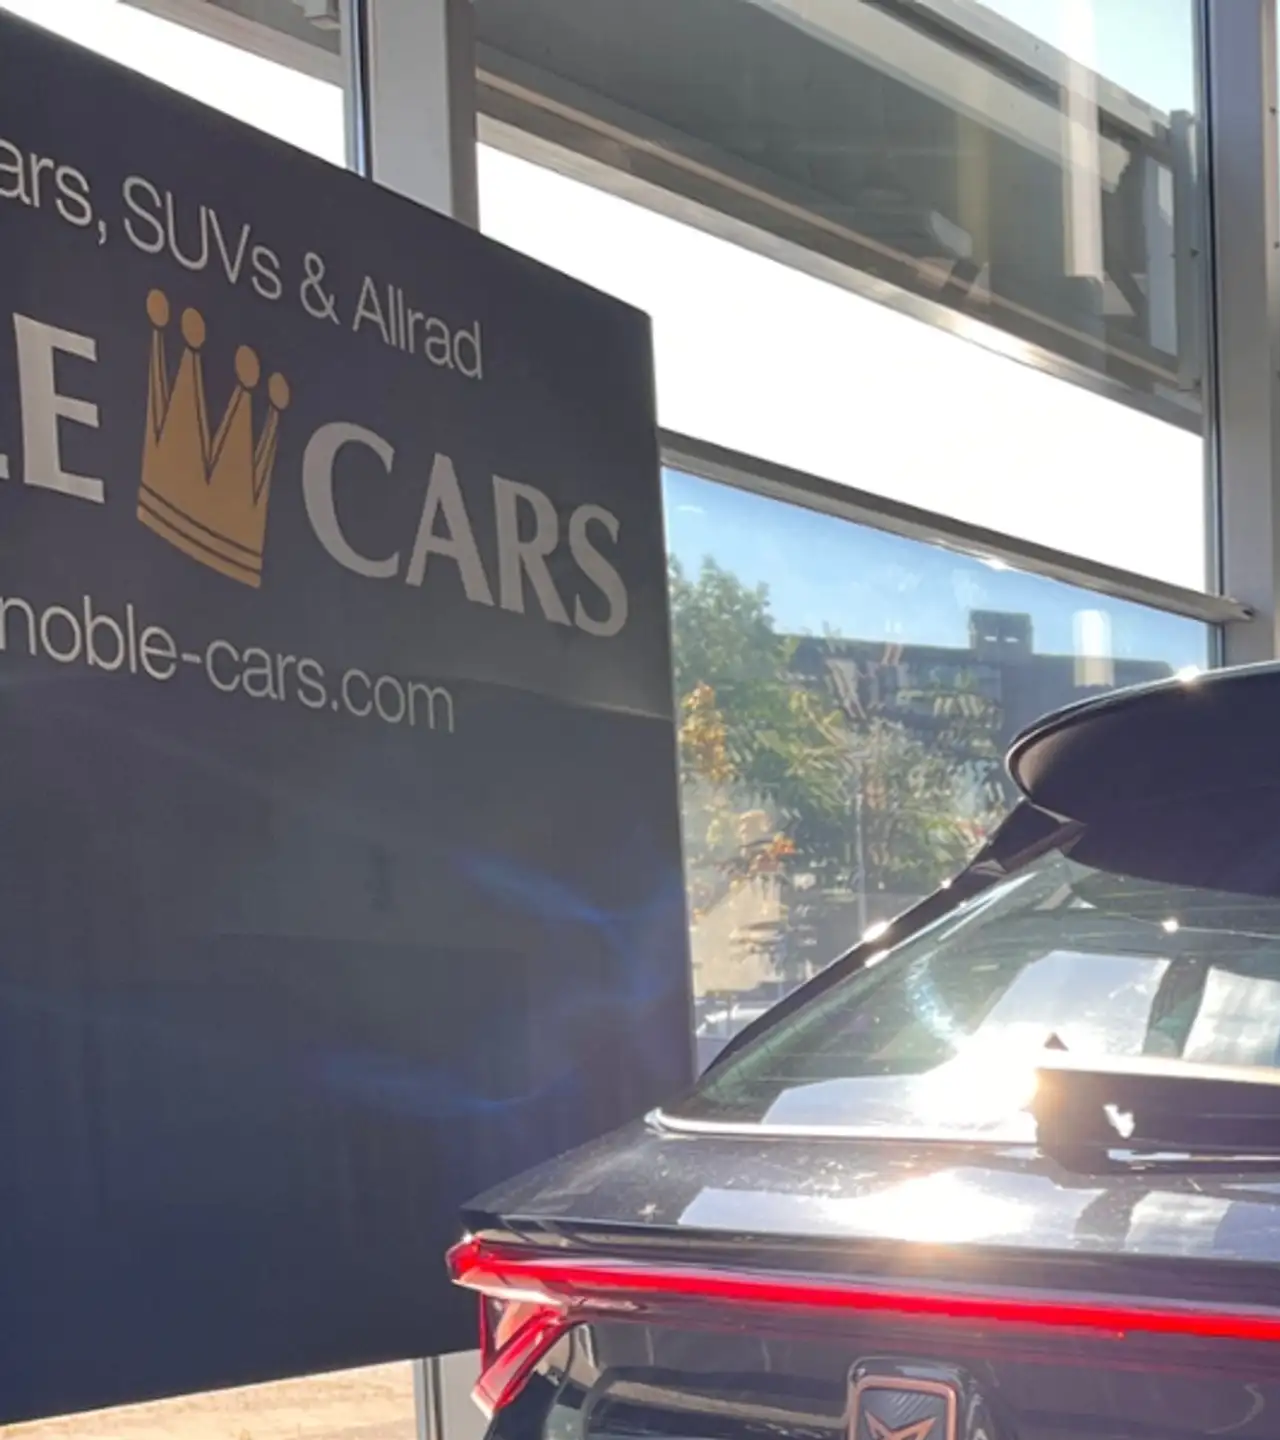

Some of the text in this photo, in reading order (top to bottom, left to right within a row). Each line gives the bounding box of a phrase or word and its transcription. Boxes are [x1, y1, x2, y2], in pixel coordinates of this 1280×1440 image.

[122, 174, 283, 301] SUVs
[300, 251, 341, 326] &
[352, 274, 484, 380] Allrad
[301, 420, 629, 638] CARS
[0, 594, 456, 733] noble-cars.com
